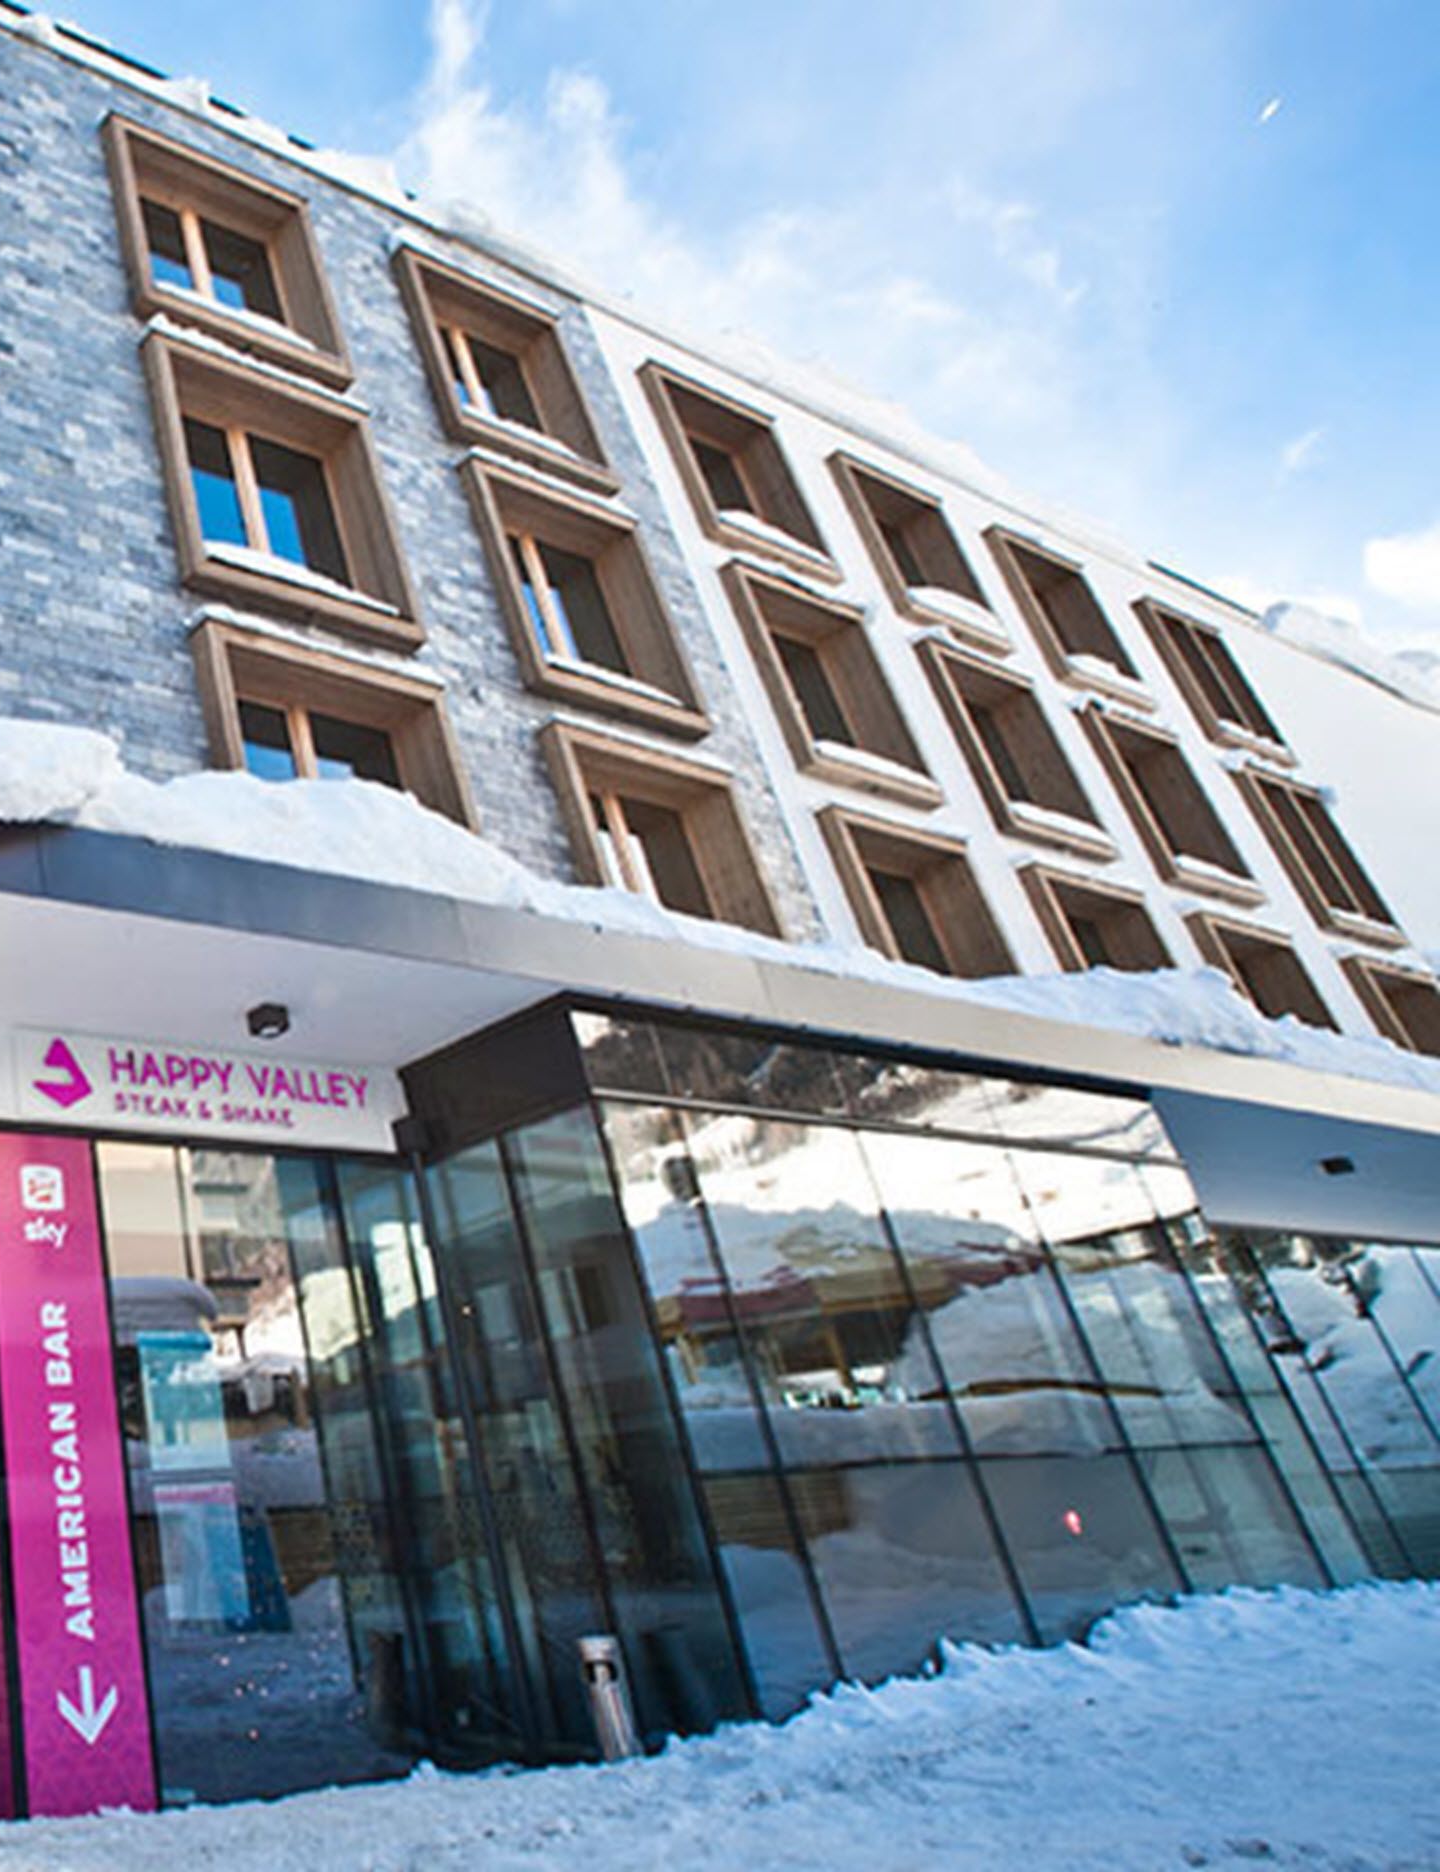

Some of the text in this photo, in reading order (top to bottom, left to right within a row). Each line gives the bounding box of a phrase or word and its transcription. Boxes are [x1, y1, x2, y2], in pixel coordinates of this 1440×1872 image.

[106, 1047, 368, 1108] HAPPY VALLEY
[114, 1092, 295, 1128] STEAK & SHAKE
[24, 1217, 68, 1248] sky
[41, 1301, 96, 1642] AMERICAN BAR
